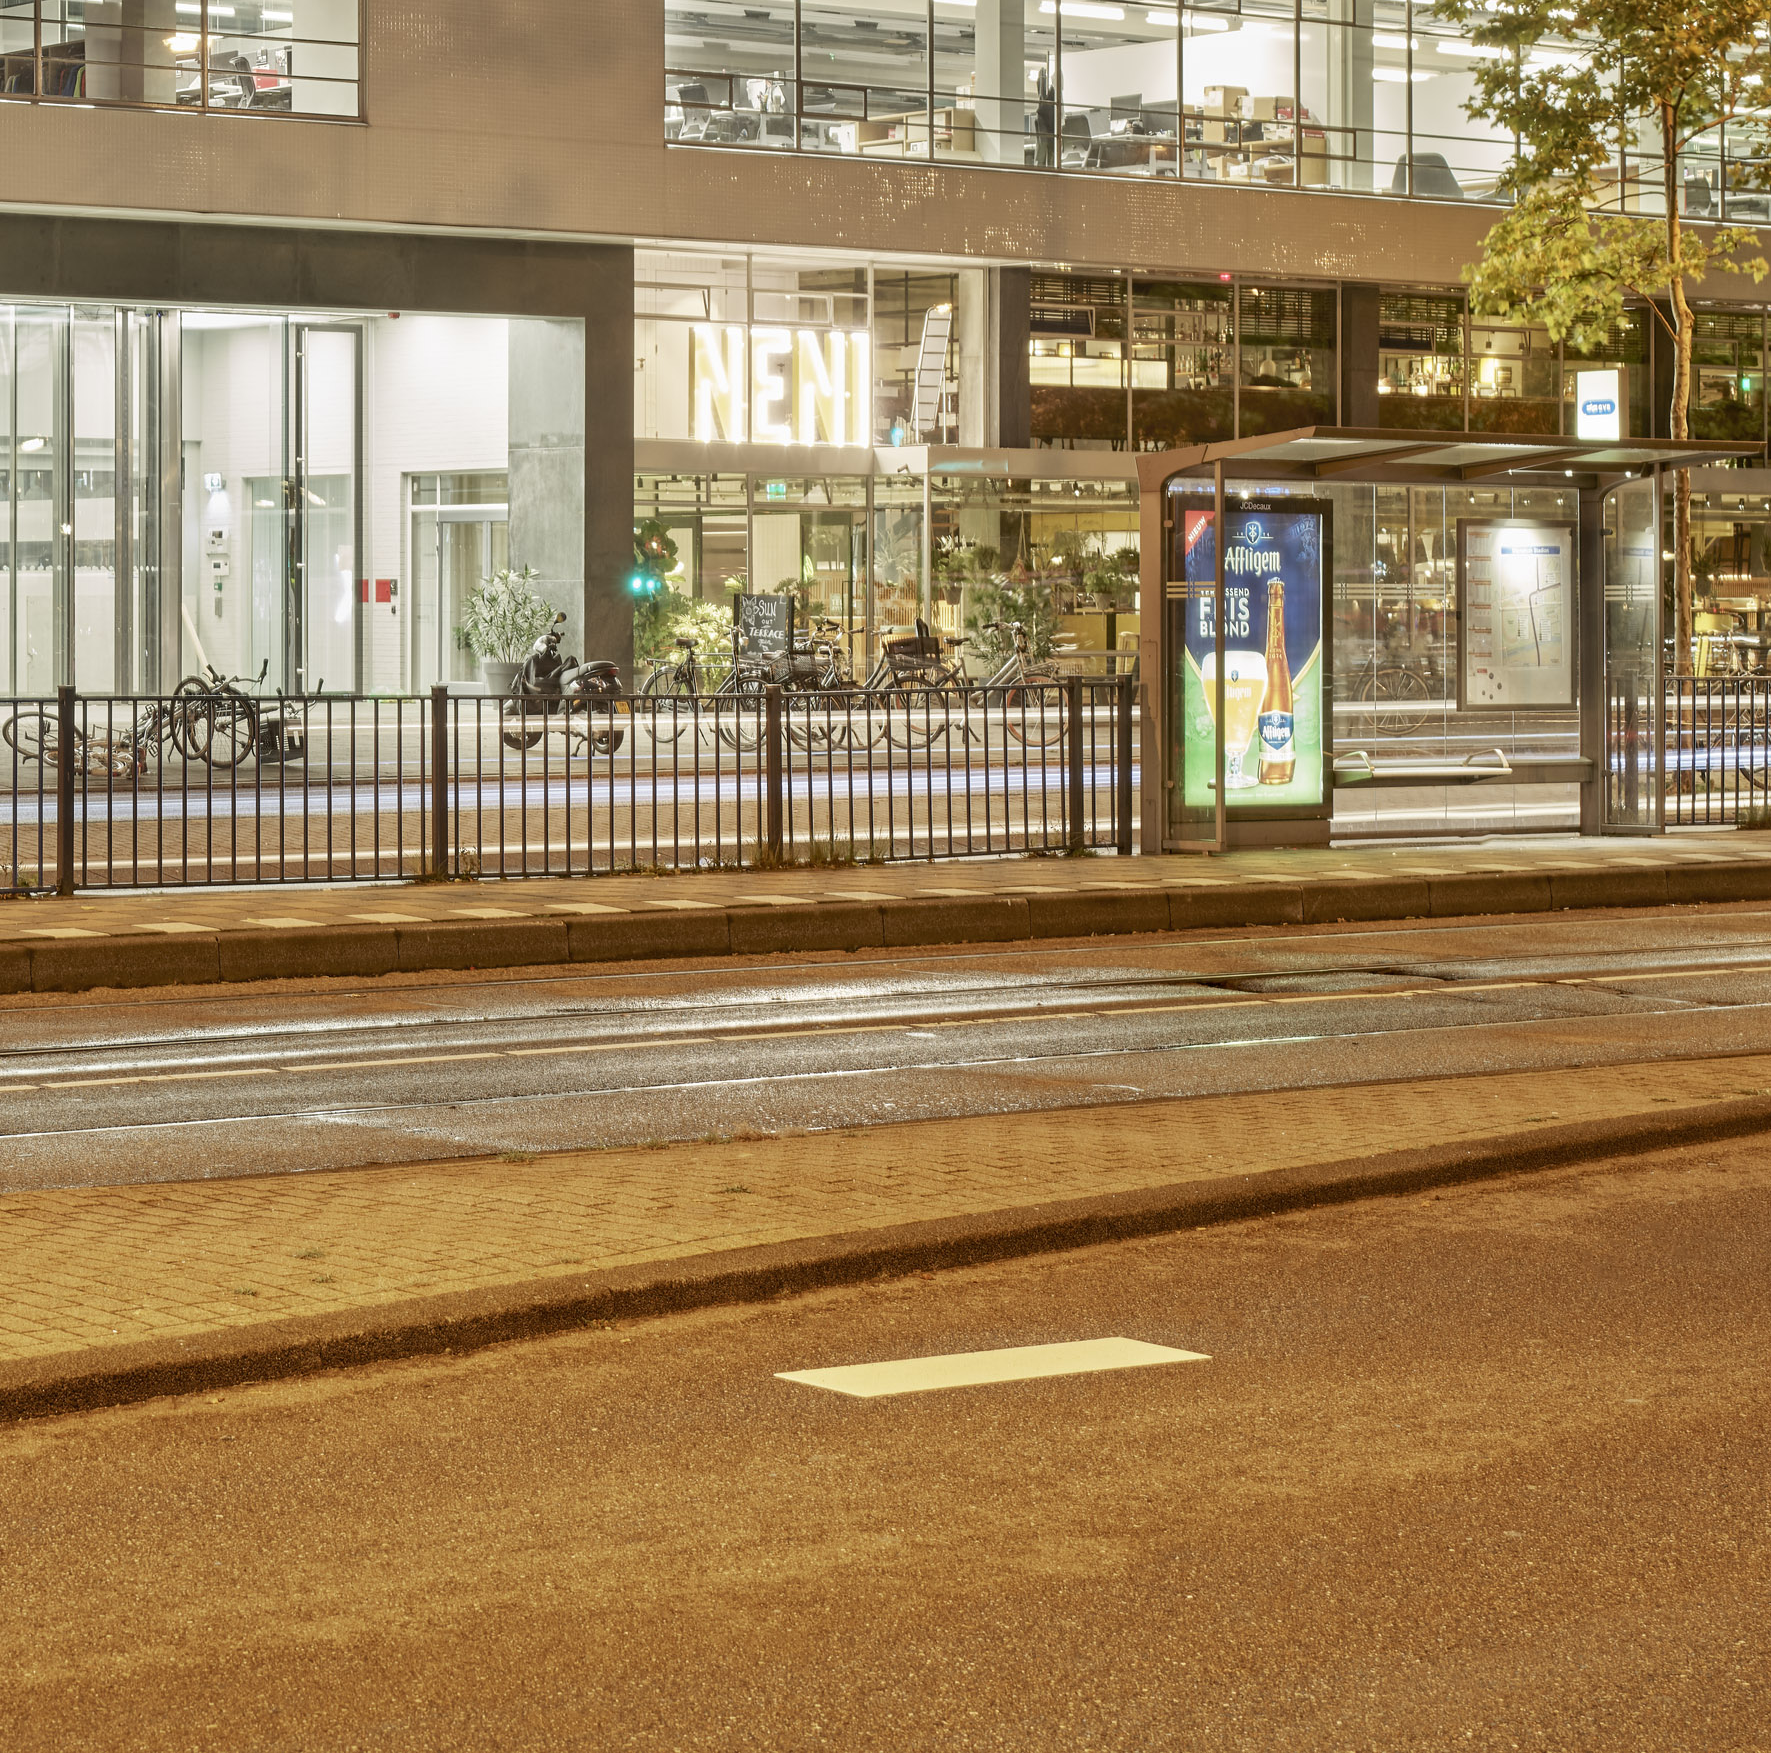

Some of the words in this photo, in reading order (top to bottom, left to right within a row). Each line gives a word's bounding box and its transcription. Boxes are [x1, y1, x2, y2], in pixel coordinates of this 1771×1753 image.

[689, 324, 870, 448] NENI
[1239, 502, 1272, 511] JCDecaux
[1188, 516, 1207, 543] NIEUW
[1224, 546, 1282, 577] Affligem
[758, 599, 777, 617] SUN
[748, 626, 785, 640] TERRACE
